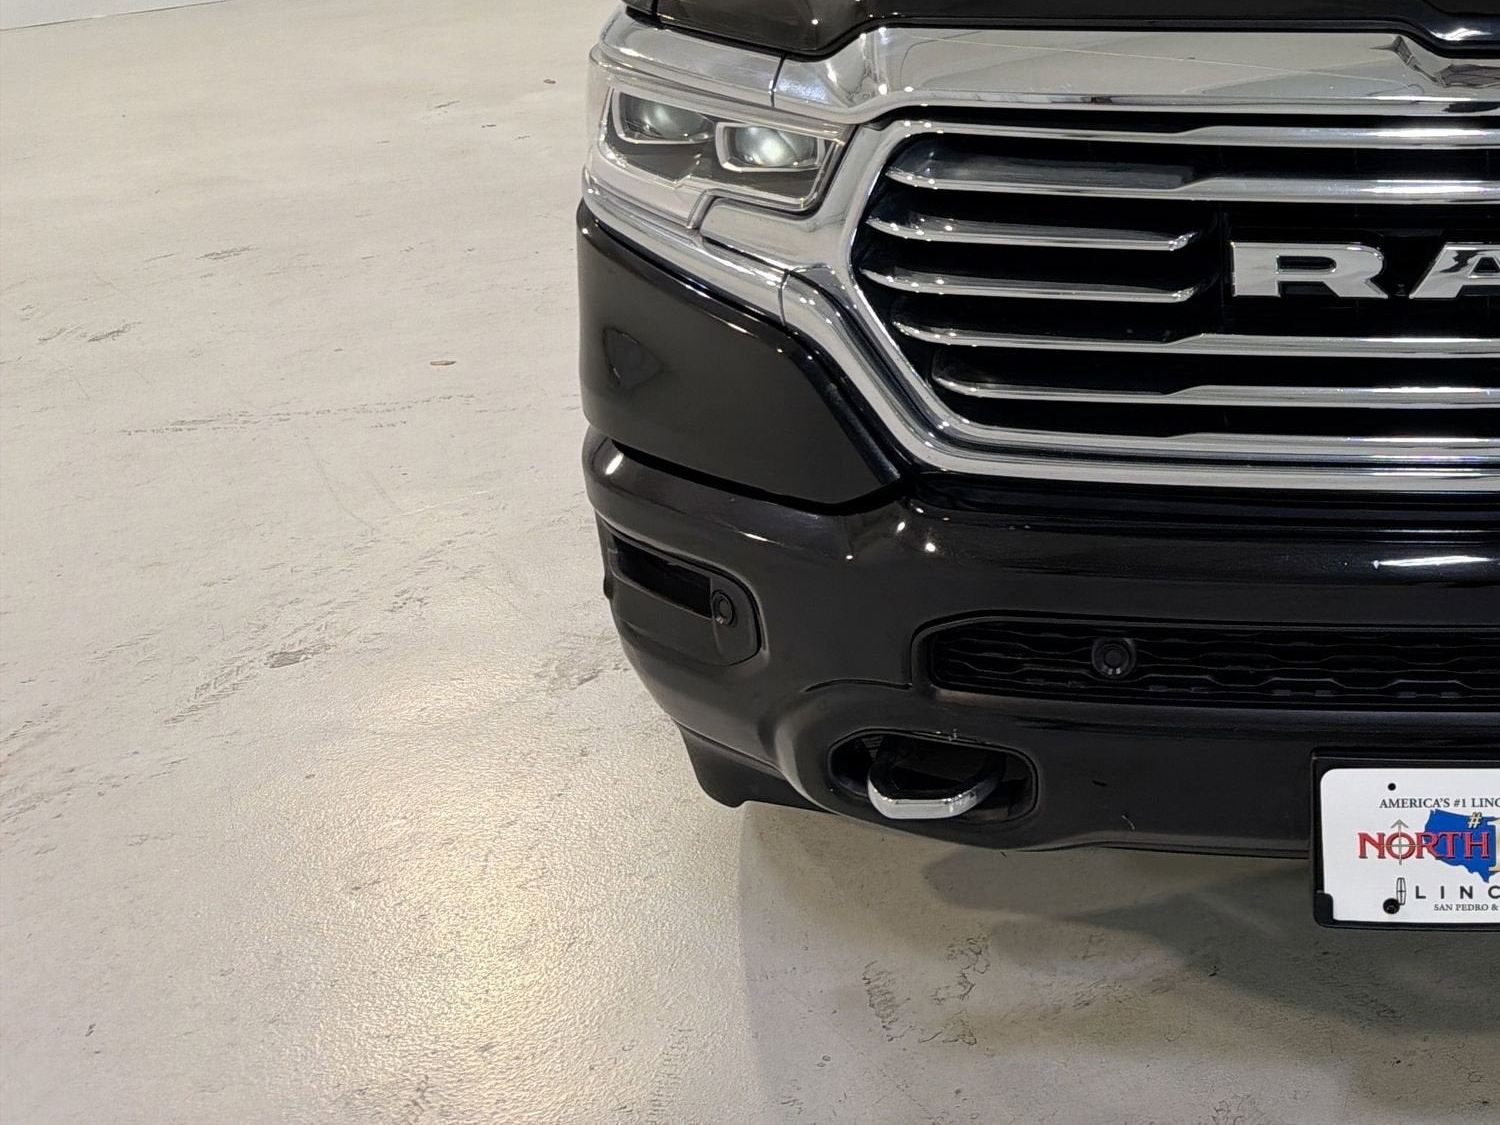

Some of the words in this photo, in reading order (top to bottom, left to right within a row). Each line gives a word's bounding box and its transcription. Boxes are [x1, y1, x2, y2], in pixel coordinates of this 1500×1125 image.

[1379, 797, 1450, 809] AMERICA'S
[1453, 798, 1467, 808] #1
[1357, 831, 1490, 860] NORTH
[1433, 903, 1453, 912] SAN
[1455, 903, 1489, 912] PEDRO
[1491, 903, 1499, 912] &
